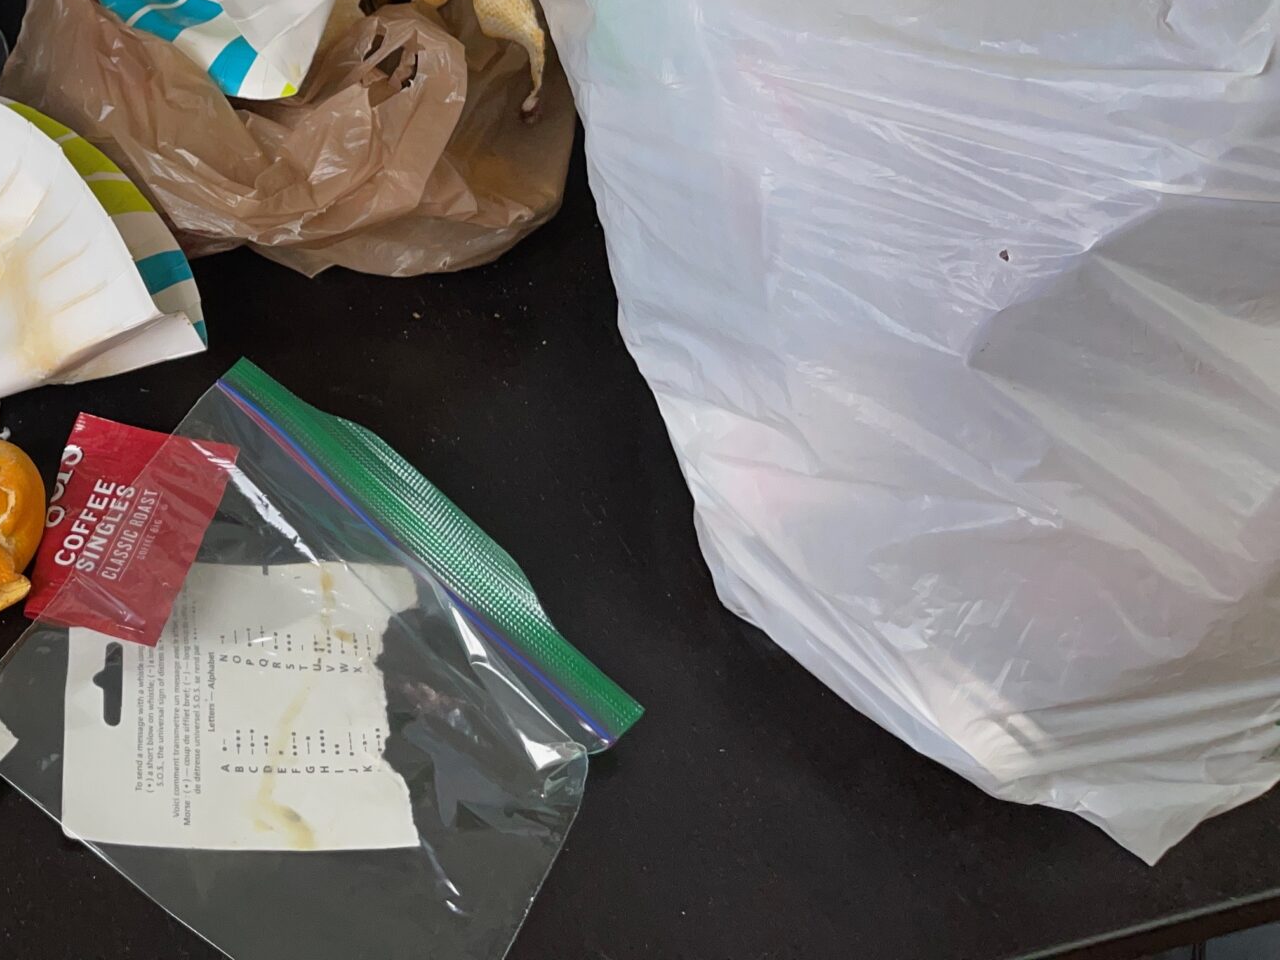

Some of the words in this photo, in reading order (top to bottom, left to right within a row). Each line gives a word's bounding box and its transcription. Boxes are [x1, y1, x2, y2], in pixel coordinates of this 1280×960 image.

[54, 478, 116, 567] COFFEE
[78, 483, 134, 572] SINGLES
[101, 527, 138, 579] CLASSIC
[128, 487, 158, 527] ROAST
[206, 651, 215, 688] Alphabet
[232, 655, 241, 663] O
[259, 658, 269, 666] Q
[339, 663, 348, 672] W
[137, 663, 145, 687] whistle
[136, 696, 144, 714] with
[156, 688, 166, 704] sign
[155, 706, 164, 742] universal
[207, 703, 215, 731] Letters
[136, 716, 145, 750] message
[146, 724, 154, 745] blow
[171, 707, 181, 755] transmettre
[191, 710, 201, 746] universel
[145, 747, 154, 768] short
[155, 744, 164, 758] the
[135, 760, 143, 779] send
[172, 757, 180, 795] comment
[220, 763, 229, 771] A
[263, 765, 272, 773] D
[306, 765, 315, 773] G
